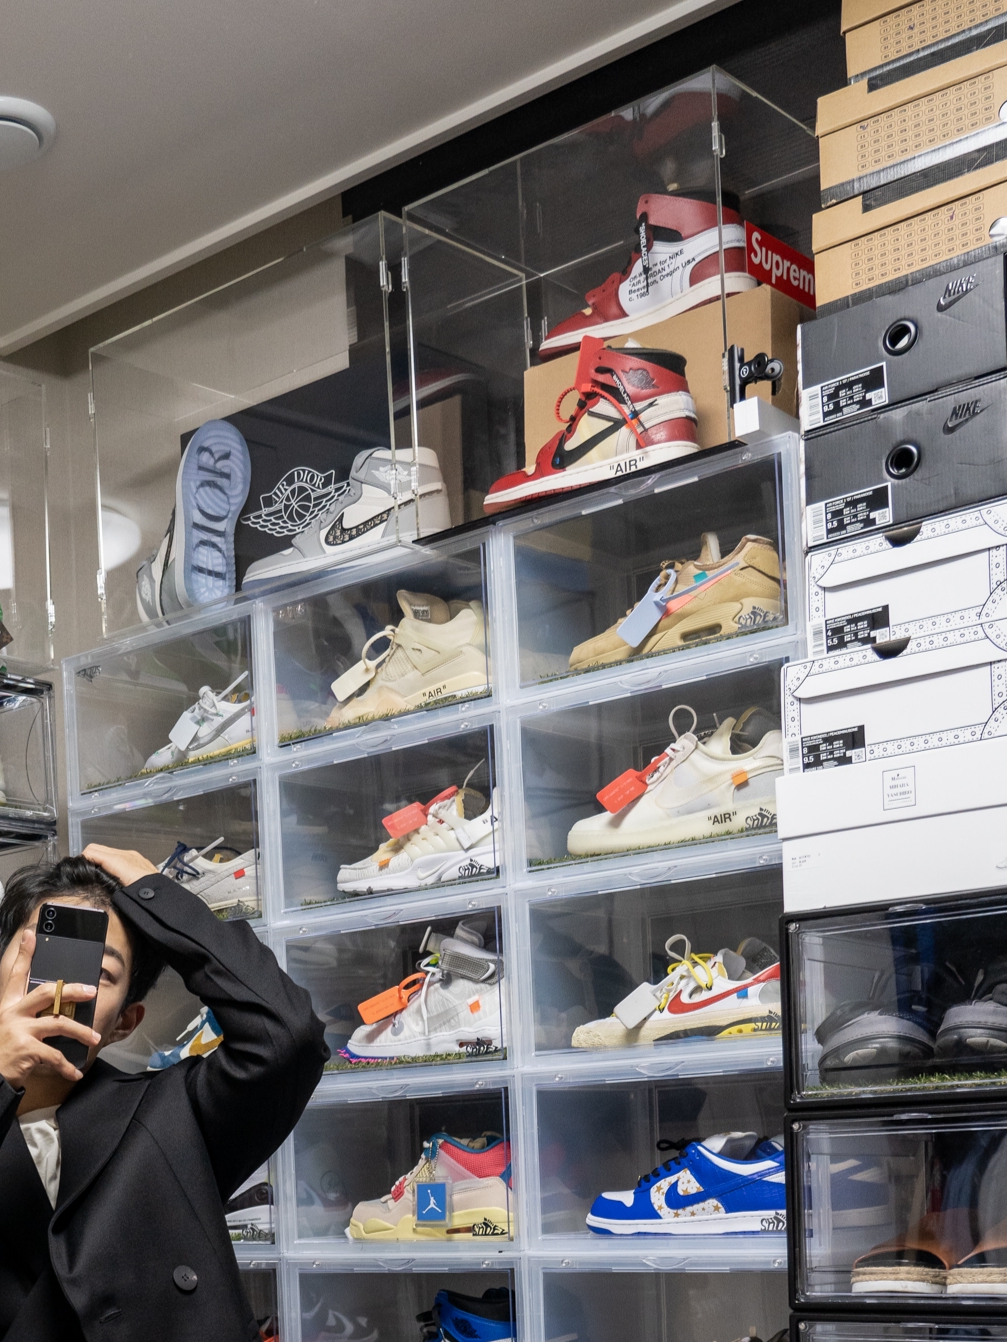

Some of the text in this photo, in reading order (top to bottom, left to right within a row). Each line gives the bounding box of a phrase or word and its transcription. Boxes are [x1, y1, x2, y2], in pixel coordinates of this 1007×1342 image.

[669, 248, 684, 261] NIKE
[750, 231, 815, 297] Suprem
[659, 266, 680, 281] Oregon
[681, 257, 696, 268] USA
[943, 273, 976, 299] NIKE
[949, 399, 982, 422] NIKE
[609, 456, 644, 475] "AIR"
[272, 469, 325, 505] AIR DIOR
[191, 446, 231, 580] DIOR
[827, 637, 838, 646] 5.5
[422, 684, 447, 700] "AIR"
[803, 755, 814, 764] 9.5
[707, 811, 737, 826] "AIR"
